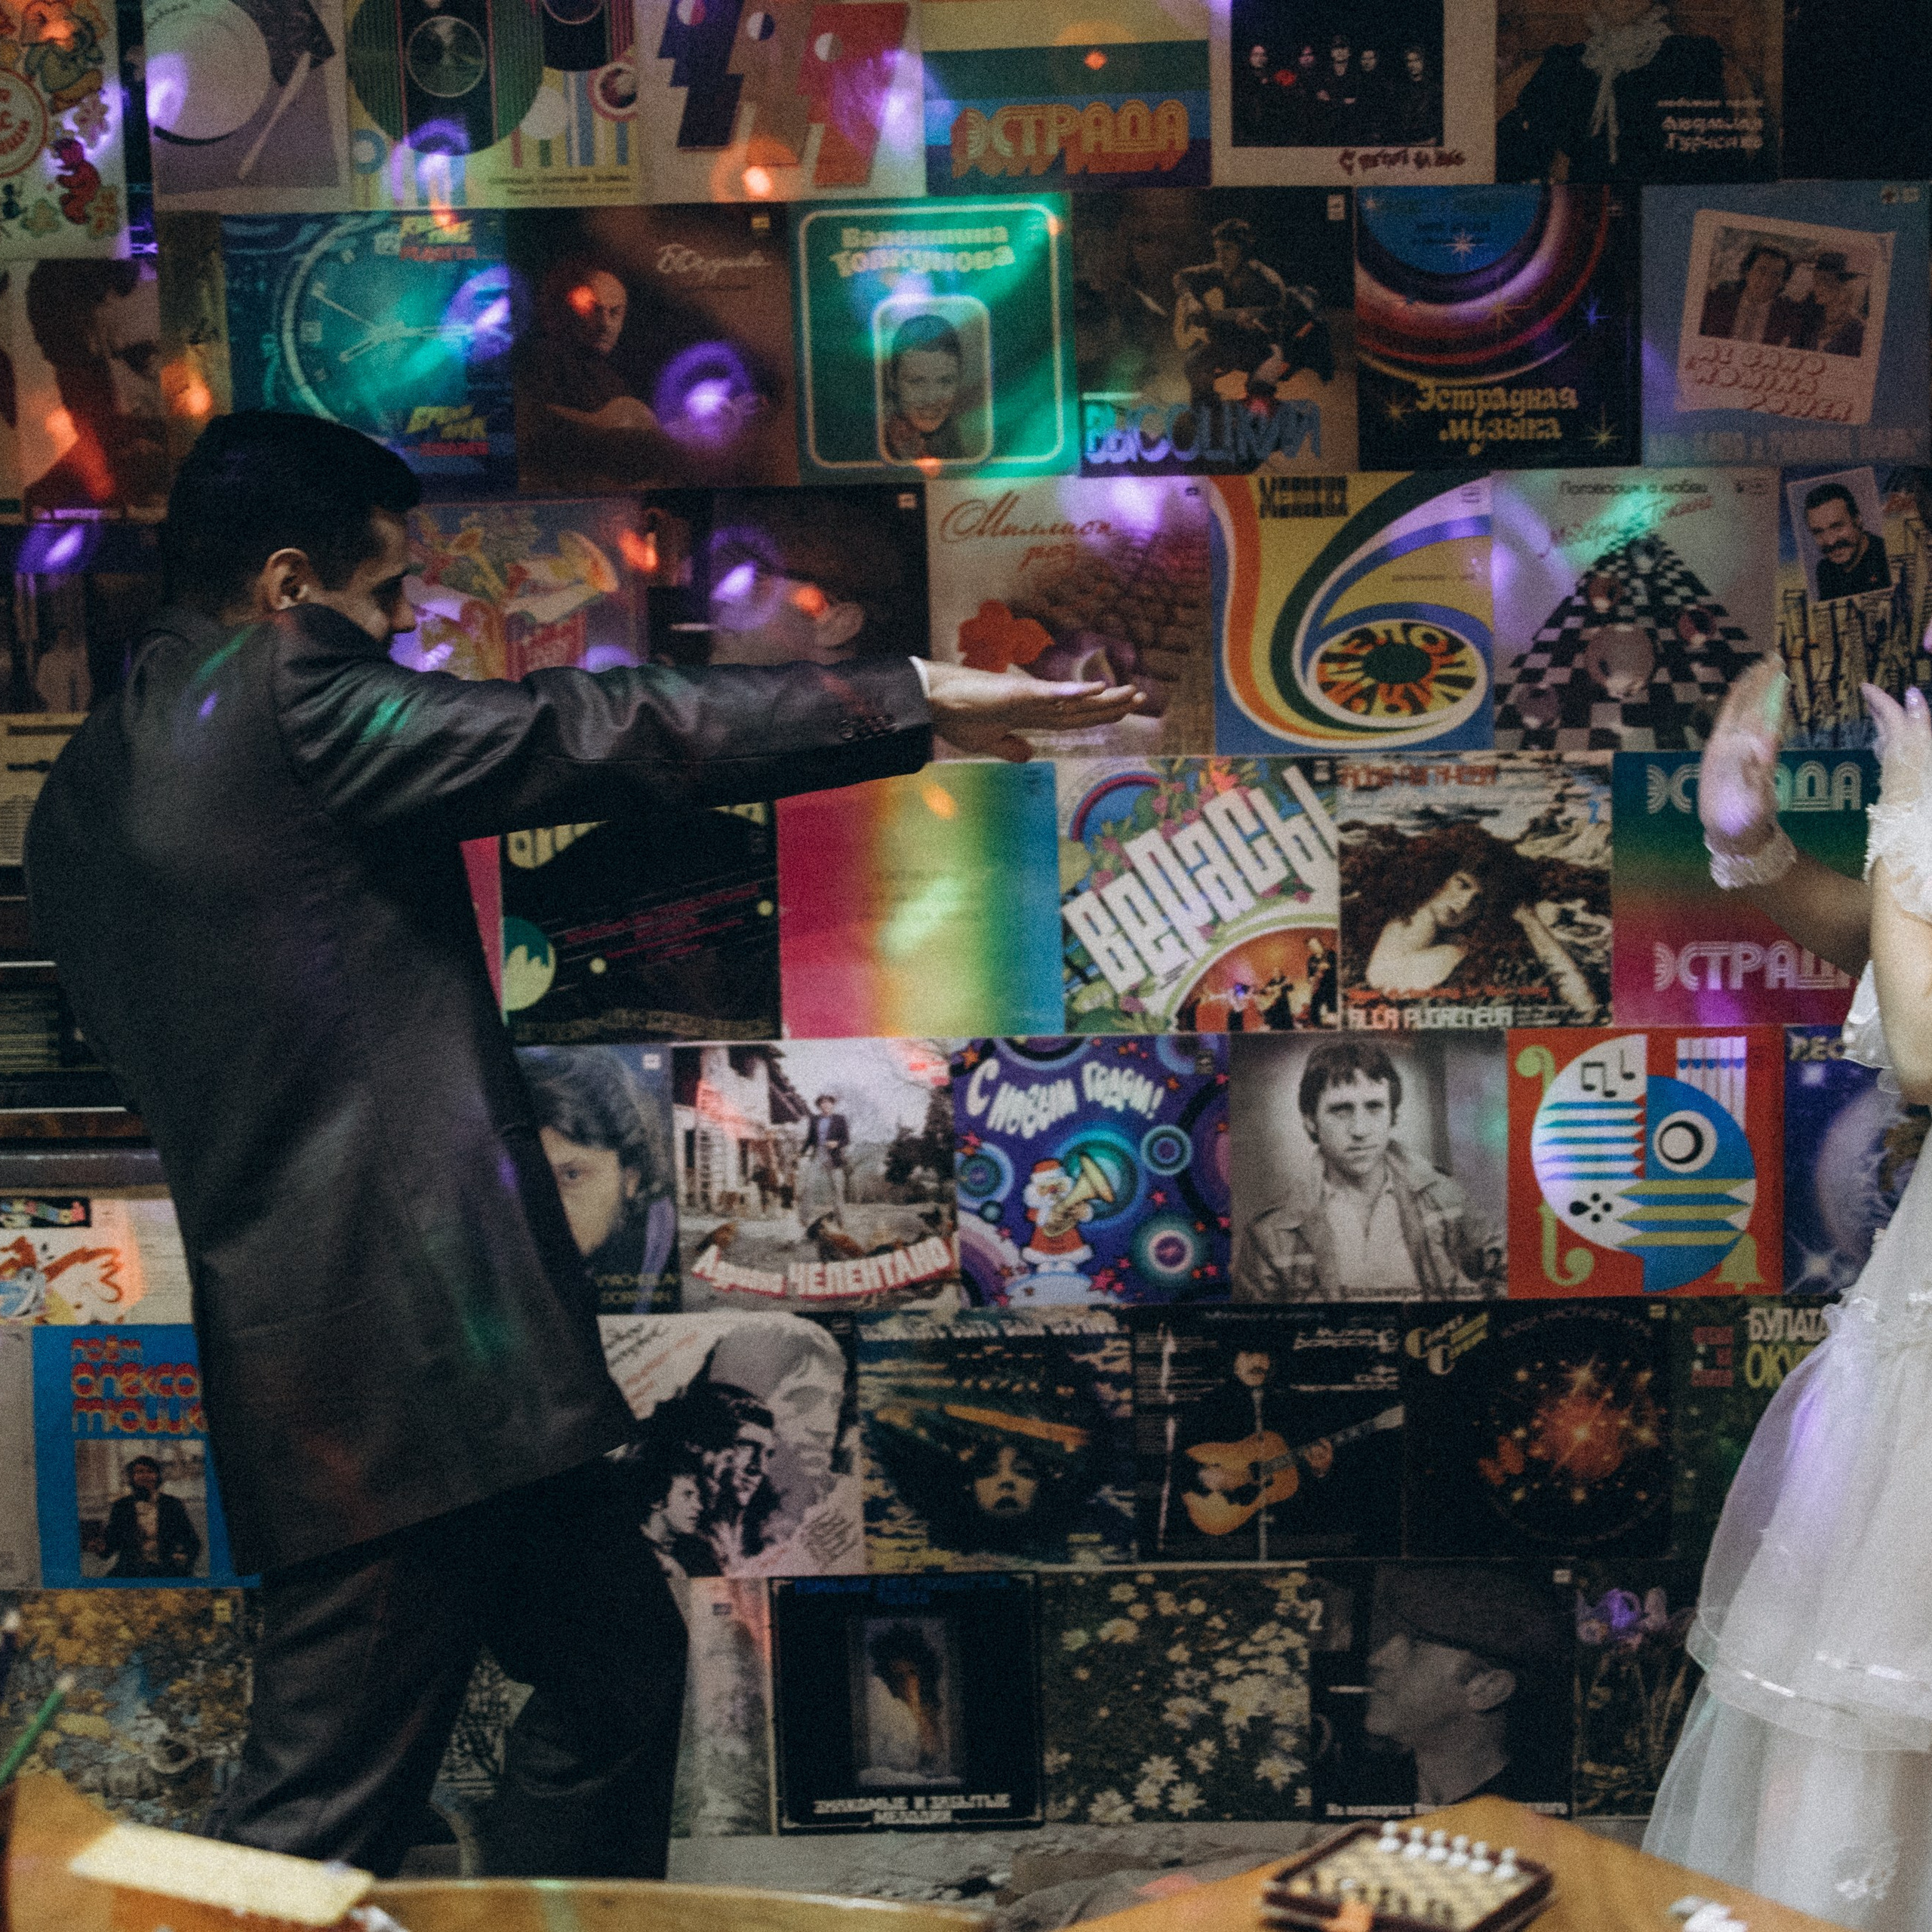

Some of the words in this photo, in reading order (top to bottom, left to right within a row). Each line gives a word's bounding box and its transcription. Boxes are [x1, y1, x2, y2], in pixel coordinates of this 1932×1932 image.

[952, 100, 1190, 172] ЭСТРАДА
[1416, 380, 1579, 417] Эстрадная
[1646, 759, 1862, 816] ЭСАДА
[1654, 939, 1858, 992] ЭСТРАД
[789, 1237, 954, 1300] ЧЕЛЕНТАНО
